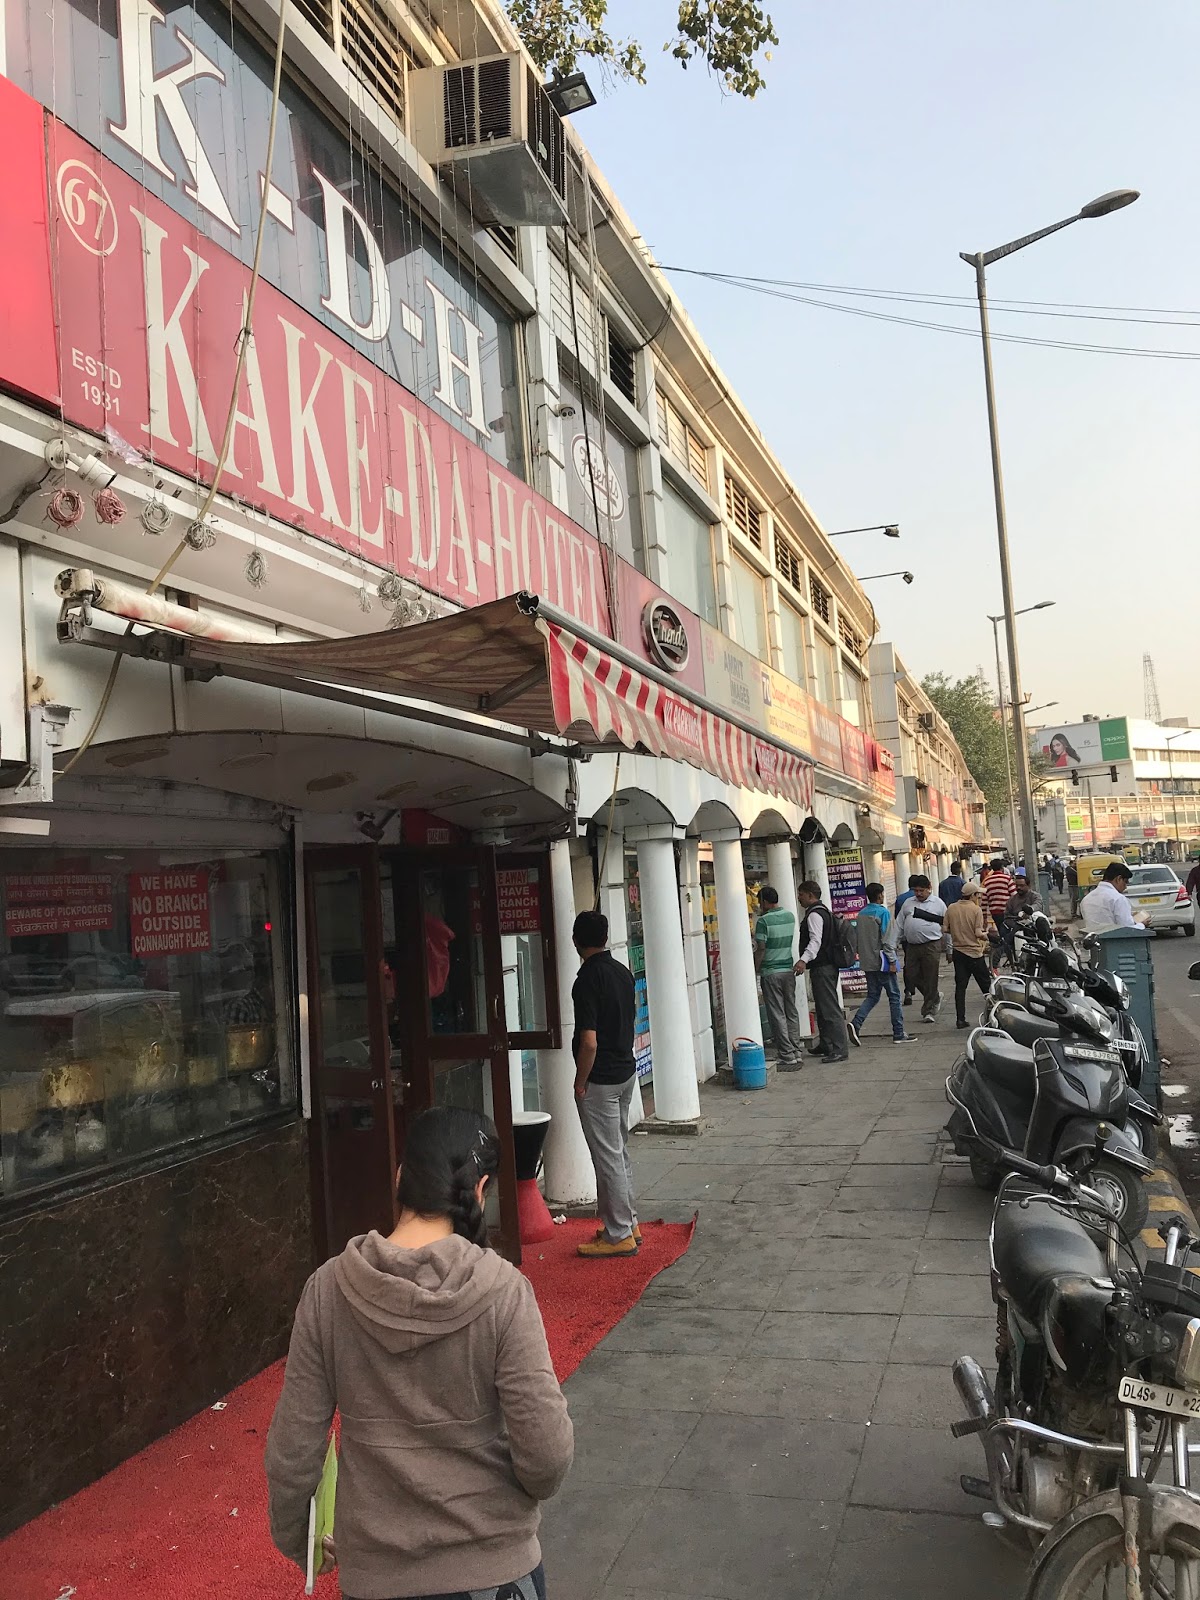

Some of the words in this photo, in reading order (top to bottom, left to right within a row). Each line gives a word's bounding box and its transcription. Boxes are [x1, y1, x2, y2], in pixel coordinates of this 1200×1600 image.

[64, 174, 109, 242] 67
[71, 347, 122, 391] ESTD
[80, 379, 121, 417] 1931
[836, 864, 861, 872] PRINTING
[841, 872, 862, 880] PRINTING
[140, 876, 161, 891] WE
[164, 874, 197, 890] HAVE
[505, 871, 527, 884] AWAY
[500, 886, 530, 896] HAVE
[132, 896, 152, 915] NO
[155, 892, 207, 914] BRANCH
[498, 896, 539, 908] RANCH
[5, 908, 42, 920] BEWARE
[44, 908, 55, 917] OF
[57, 904, 113, 916] PICKPOCKETS
[499, 908, 530, 918] TSIDE
[61, 919, 70, 929] से
[74, 917, 108, 928] सावधान
[142, 915, 201, 932] OUTSIDE
[516, 920, 538, 930] PLACE
[134, 932, 184, 953] CONNAUGHT
[186, 930, 209, 948] PLACE
[1123, 1383, 1150, 1401] DL4S
[1166, 1392, 1174, 1406] U
